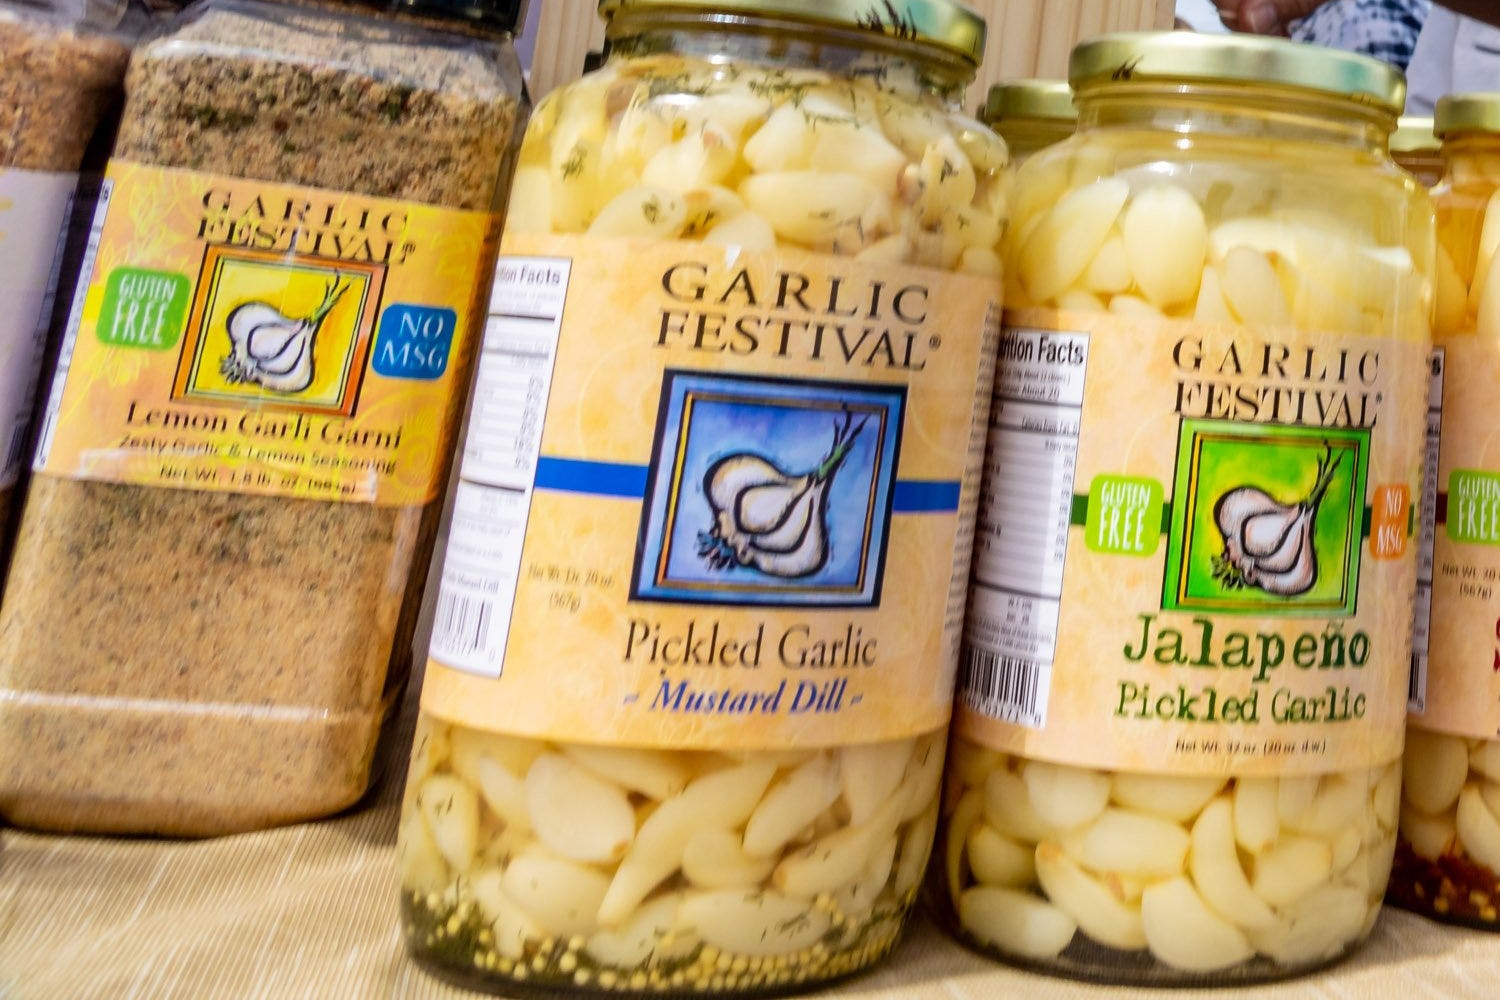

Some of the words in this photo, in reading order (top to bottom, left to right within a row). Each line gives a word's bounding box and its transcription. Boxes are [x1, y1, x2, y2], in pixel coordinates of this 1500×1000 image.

[202, 187, 409, 234] GARLIC
[118, 268, 177, 299] GLUTEN
[519, 264, 561, 286] Facts
[661, 260, 930, 326] GARLIC
[109, 302, 167, 345] FREE
[399, 310, 445, 341] NO
[379, 342, 444, 371] MSG
[1038, 333, 1085, 366] Facts
[1172, 335, 1380, 384] GARLIC
[126, 400, 229, 433] Lemon
[319, 418, 402, 450] Garni
[1100, 480, 1152, 508] GLUTEN
[1385, 486, 1403, 518] NO
[1096, 506, 1146, 553] FREE
[1457, 499, 1500, 541] FREE
[622, 619, 766, 668] Pickled
[777, 625, 879, 669] Garlic
[1123, 614, 1371, 683] Jalapeño
[648, 678, 786, 715] Mustard
[789, 681, 846, 715] Dill
[1113, 679, 1260, 724] Pickled
[1270, 685, 1367, 725] Garlic
